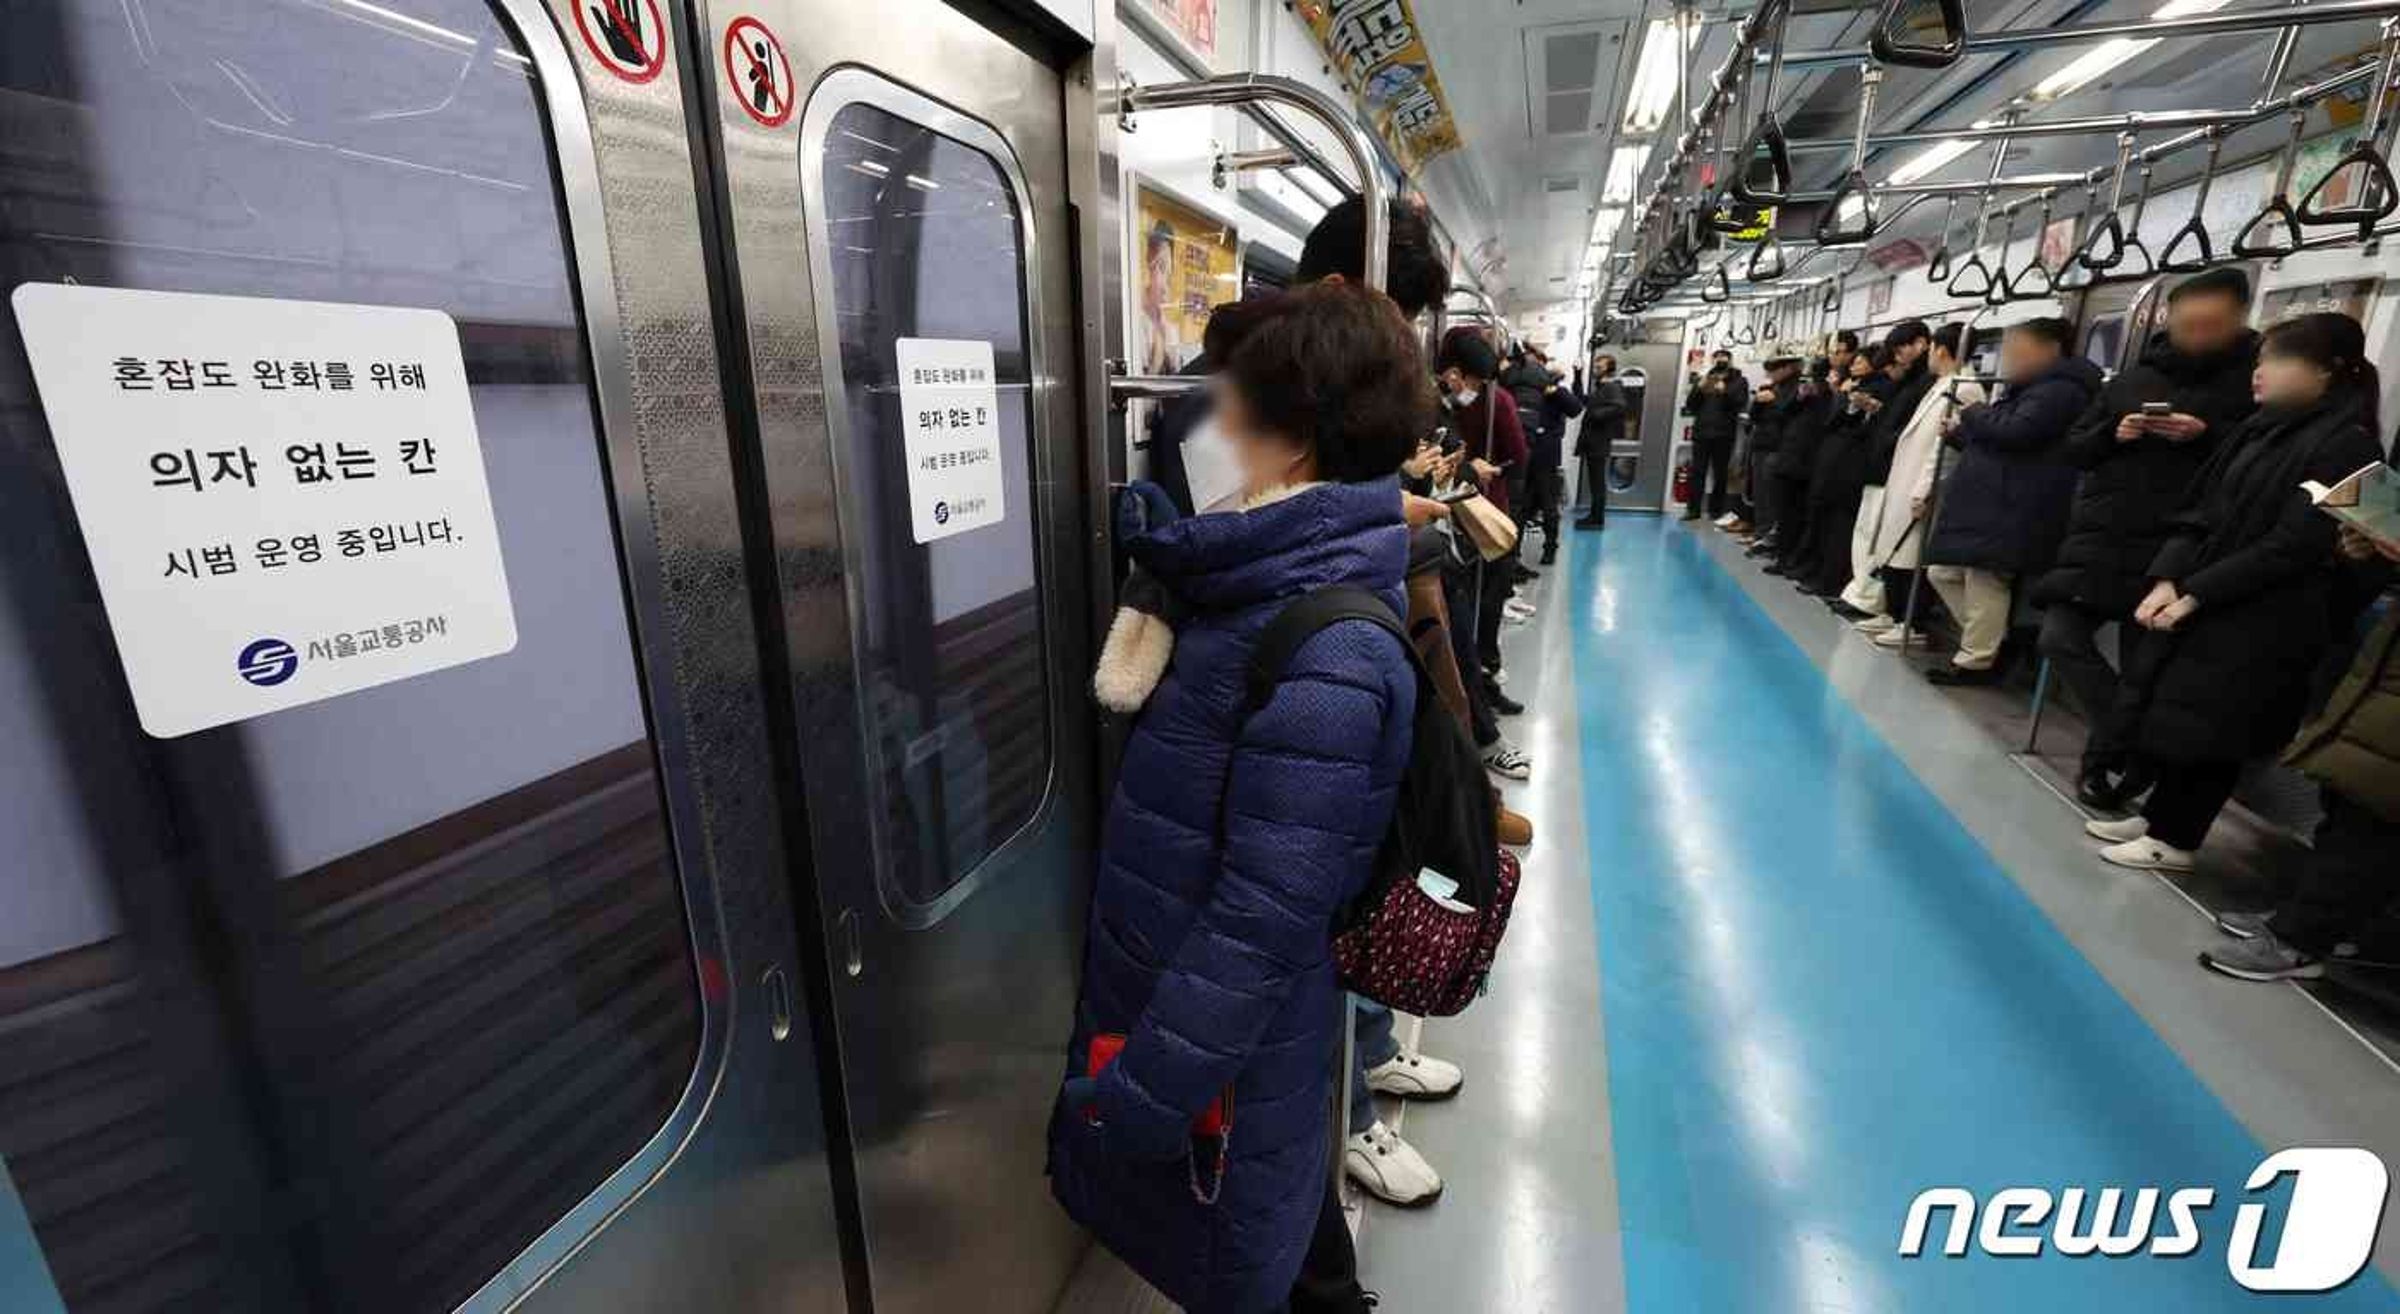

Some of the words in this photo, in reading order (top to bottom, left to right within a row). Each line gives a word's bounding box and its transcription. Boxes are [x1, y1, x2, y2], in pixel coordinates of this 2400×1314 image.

[112, 356, 238, 391] 혼잡도
[253, 359, 355, 391] 완화를
[370, 362, 426, 391] 위해
[919, 409, 943, 431] 의자
[150, 446, 257, 492] 의자
[286, 442, 376, 484] 없는
[399, 437, 437, 475] 칸
[163, 544, 238, 579] 시범
[254, 533, 322, 569] 운영
[336, 517, 463, 558] 중입니다.
[308, 615, 447, 661] 서울교통공사
